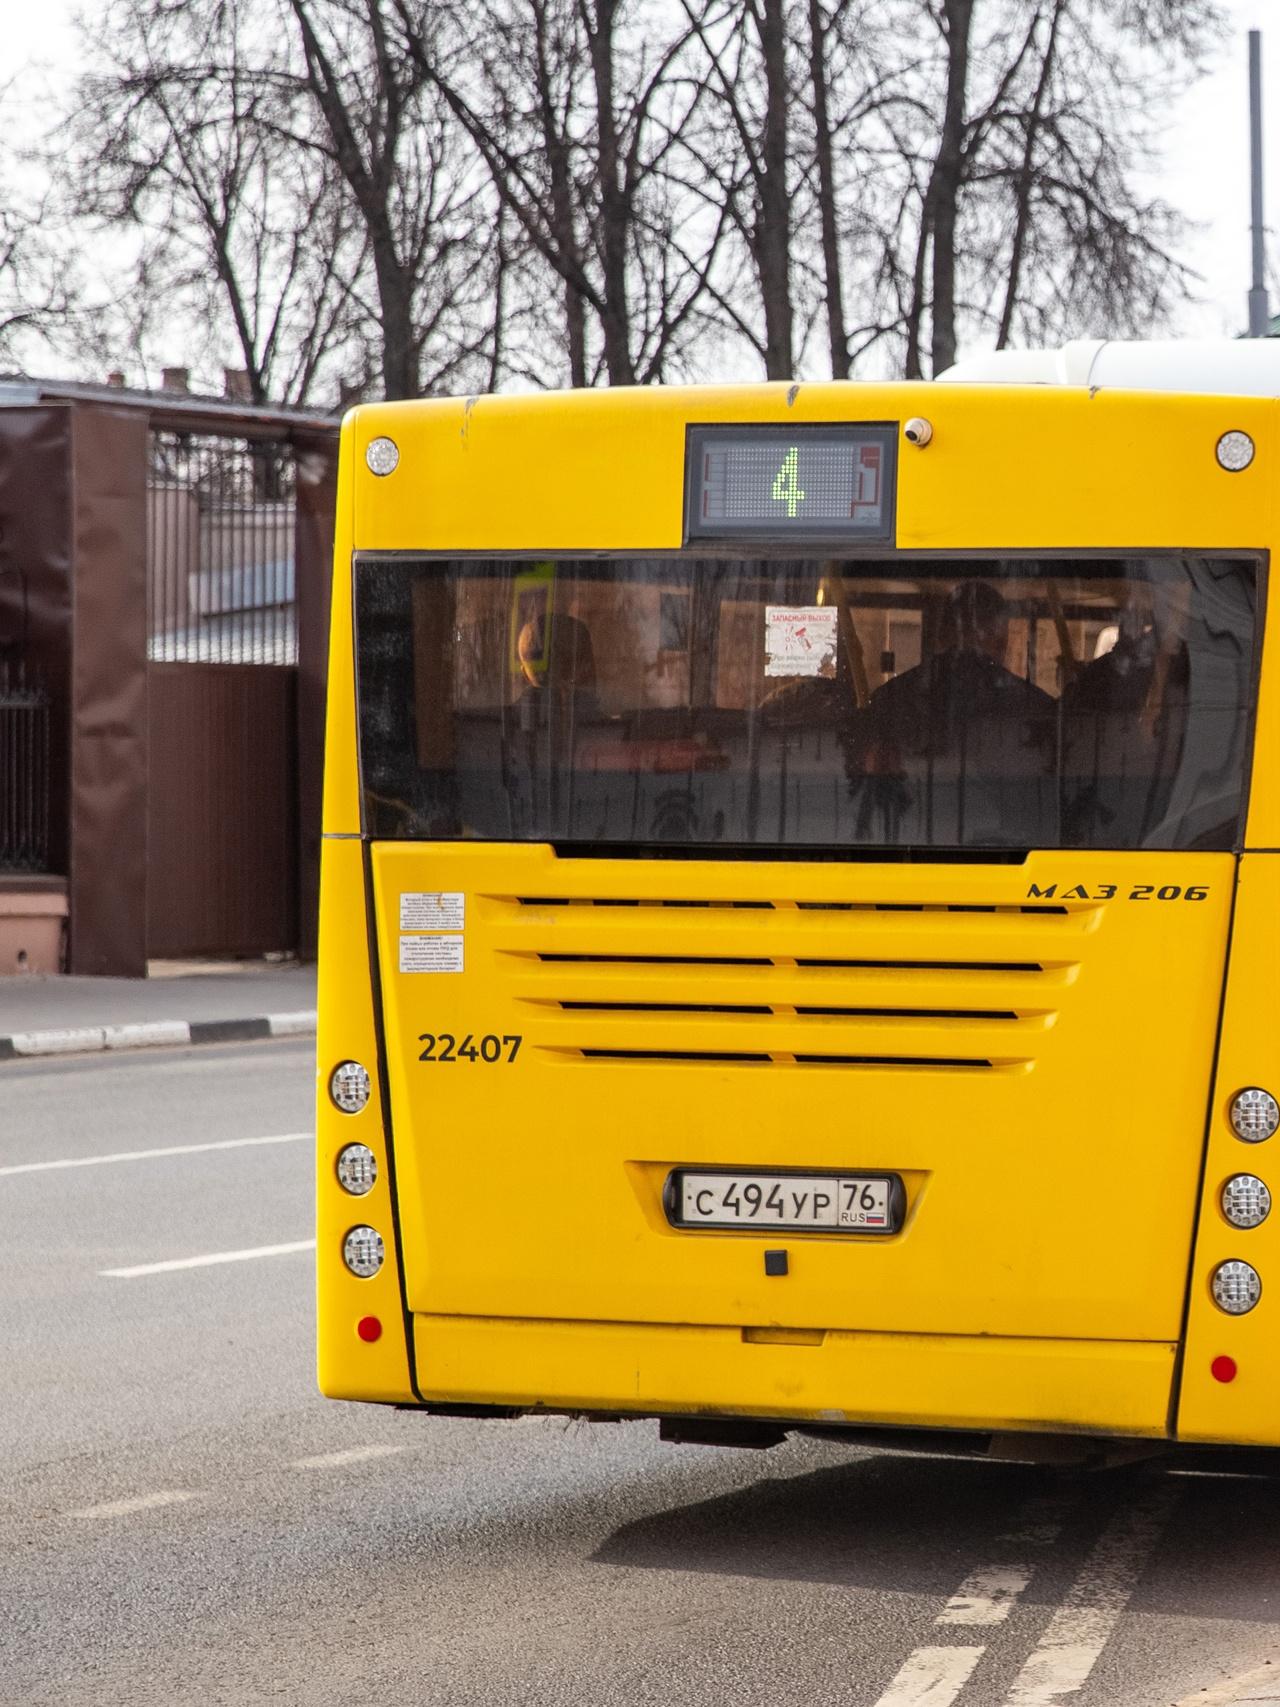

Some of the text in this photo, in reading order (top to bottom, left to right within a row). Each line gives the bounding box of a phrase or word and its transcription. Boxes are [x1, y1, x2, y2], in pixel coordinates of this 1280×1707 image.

[771, 446, 805, 518] 4
[1026, 883, 1210, 901] МАЗ 206
[418, 1033, 523, 1063] 22407
[843, 1184, 876, 1211] 76
[841, 1212, 866, 1223] RUS
